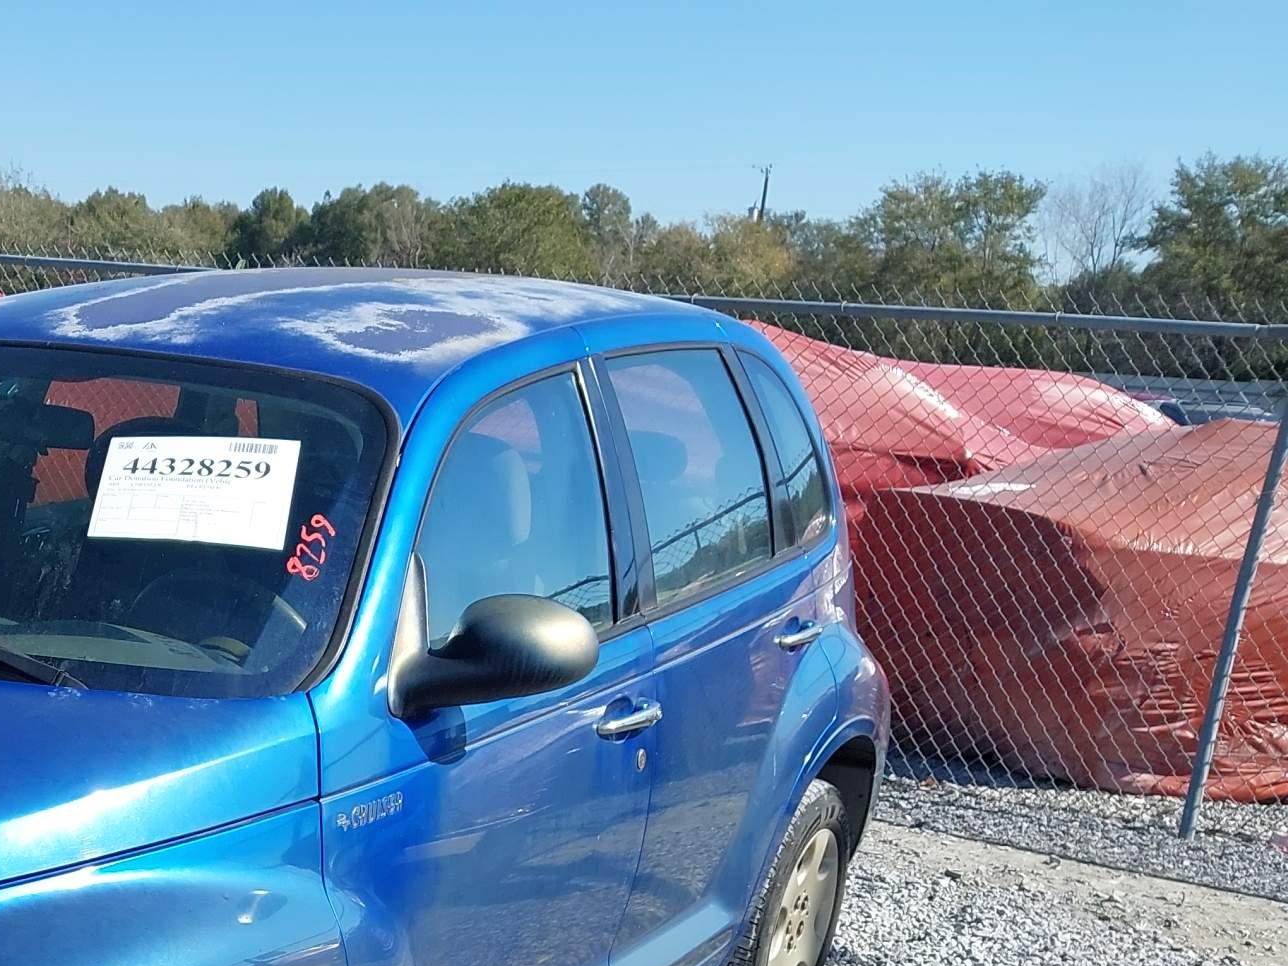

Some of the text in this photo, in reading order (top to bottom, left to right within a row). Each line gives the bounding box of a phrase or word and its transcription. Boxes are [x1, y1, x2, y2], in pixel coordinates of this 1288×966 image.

[122, 457, 271, 480] 44328259
[287, 514, 336, 581] 8259
[351, 791, 404, 829] CRUISER
